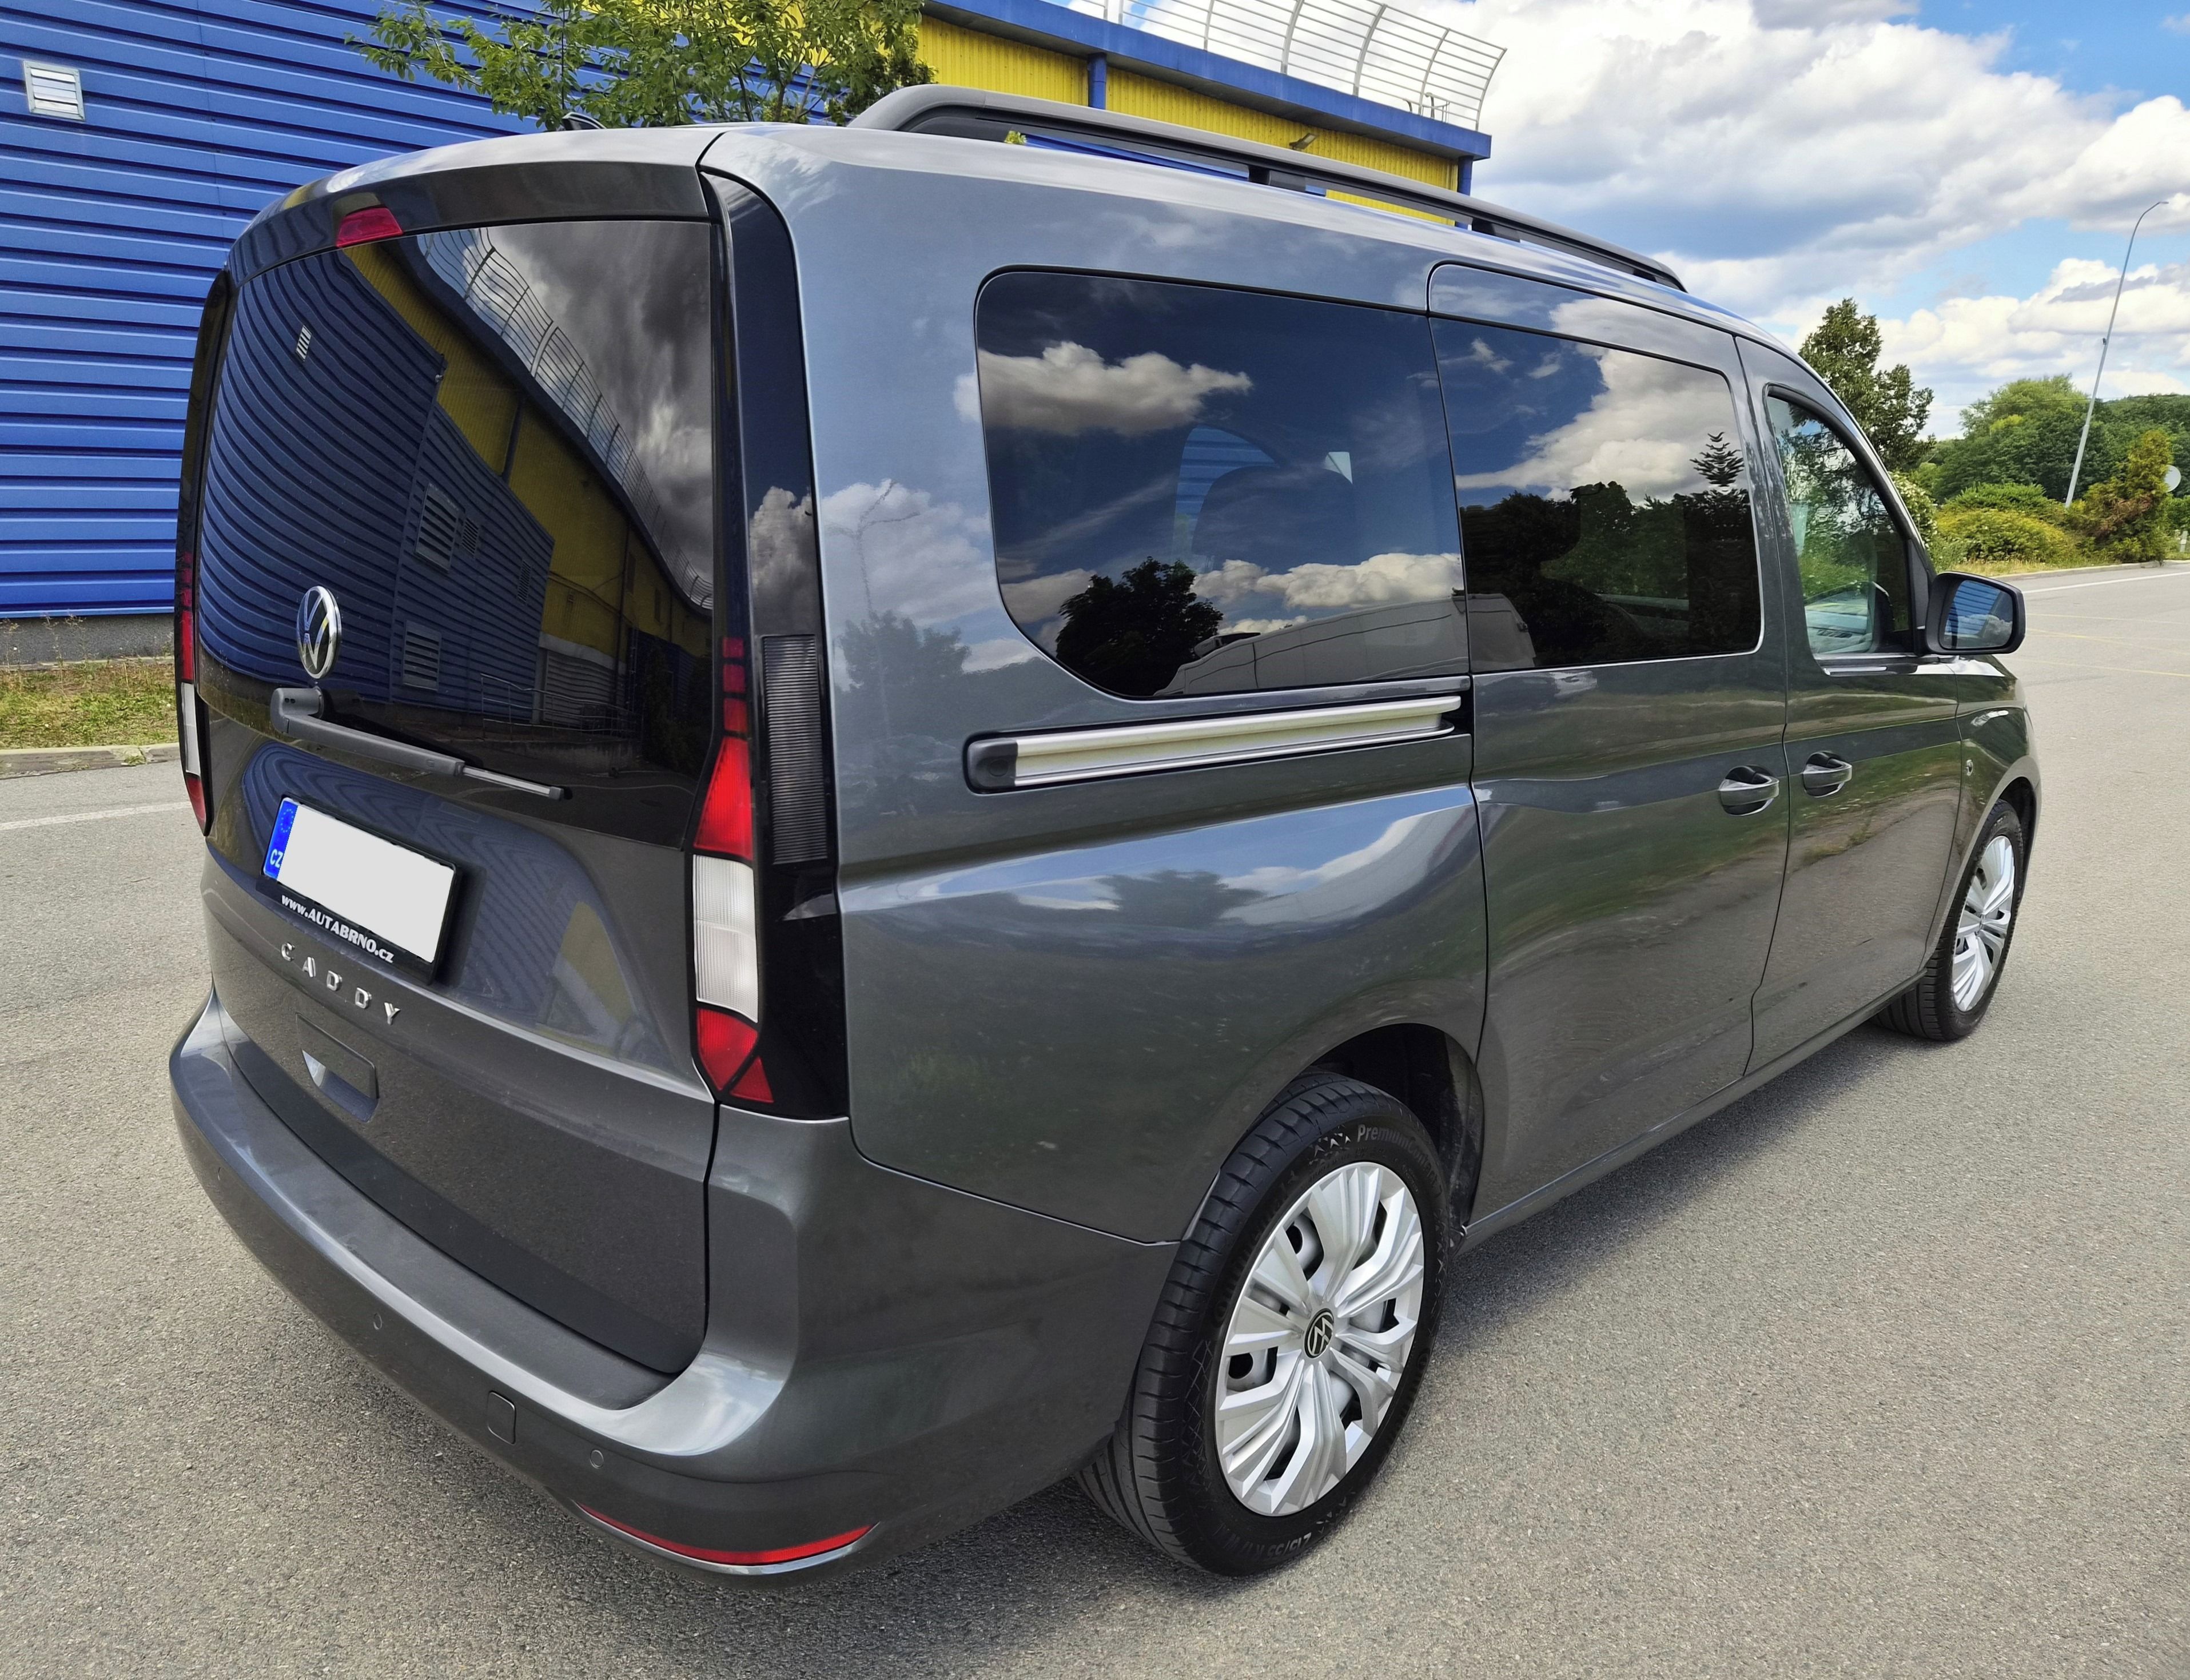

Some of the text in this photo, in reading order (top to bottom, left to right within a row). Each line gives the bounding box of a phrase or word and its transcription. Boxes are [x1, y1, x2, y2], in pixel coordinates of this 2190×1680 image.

[270, 849, 284, 868] CZ
[281, 894, 395, 964] www.AUTABRNO.cz
[281, 942, 400, 1025] CADDY
